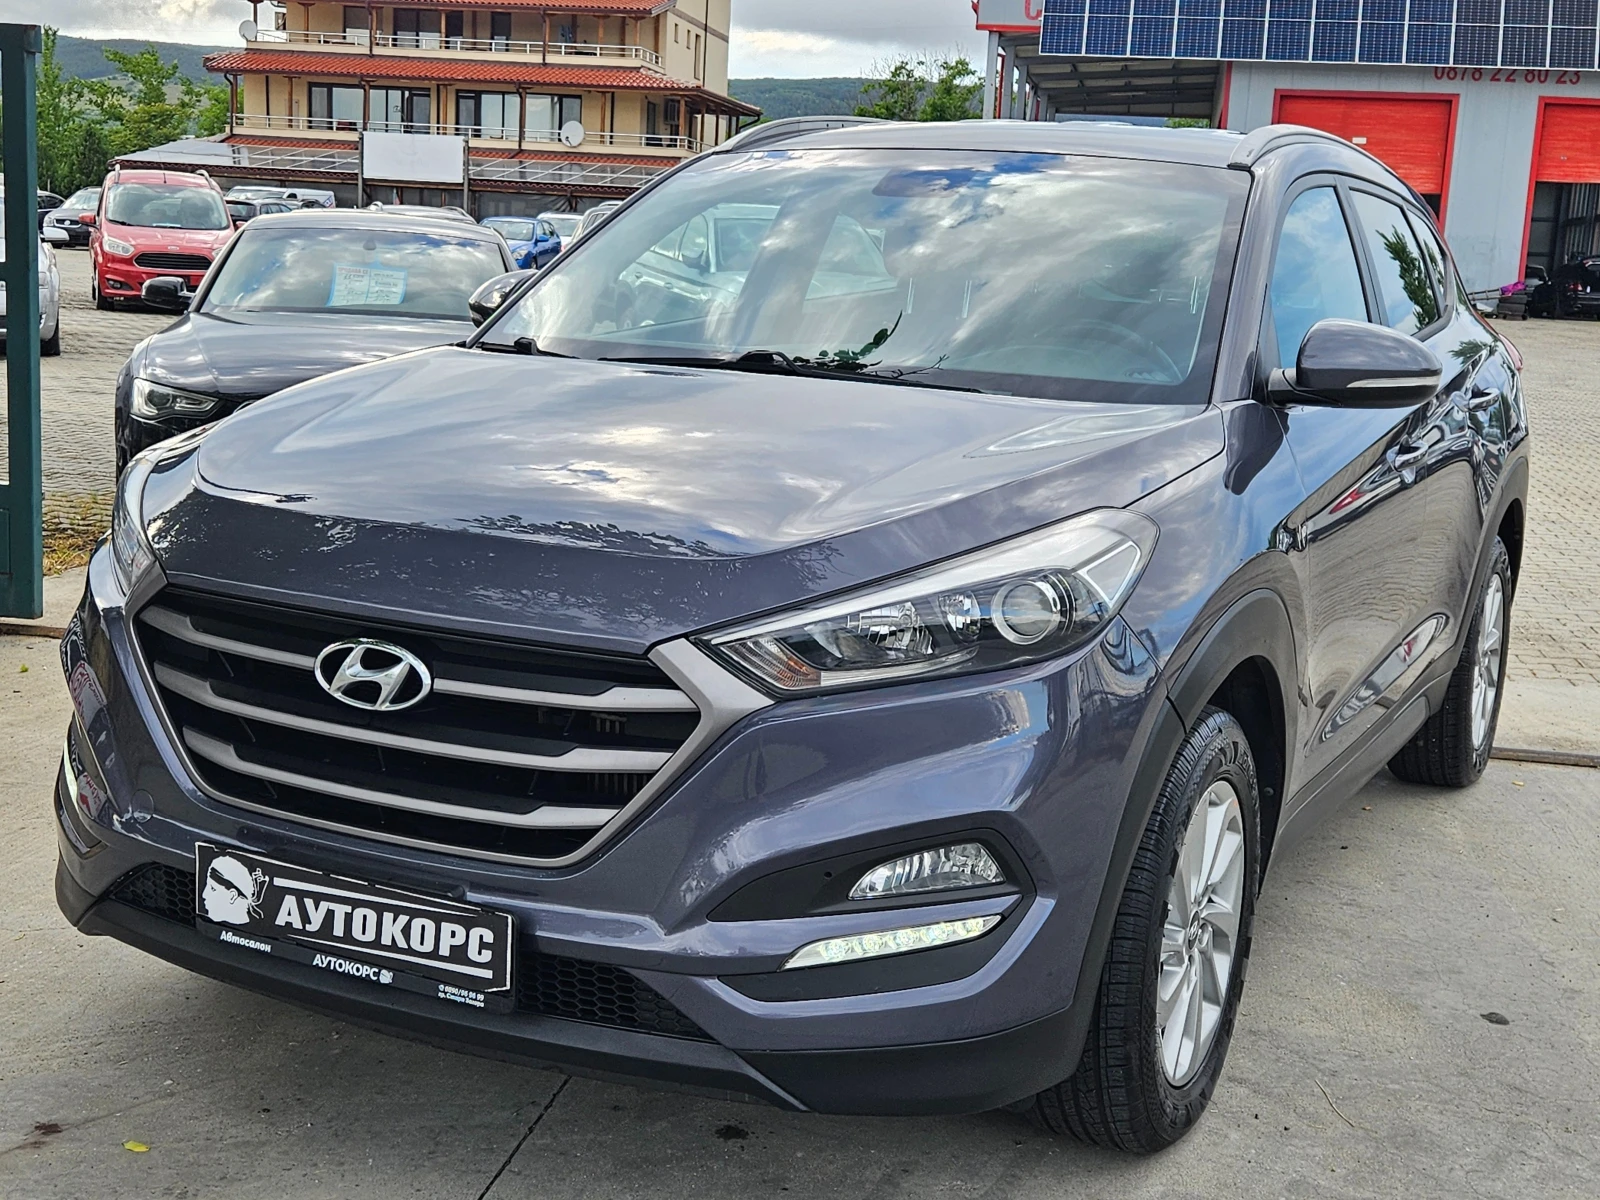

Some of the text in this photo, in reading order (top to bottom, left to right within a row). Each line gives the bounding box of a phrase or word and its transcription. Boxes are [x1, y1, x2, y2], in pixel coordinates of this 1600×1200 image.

[220, 930, 271, 953] Автосалон
[275, 894, 495, 963] АУТОКОРС
[312, 954, 379, 981] АУТОКОРС
